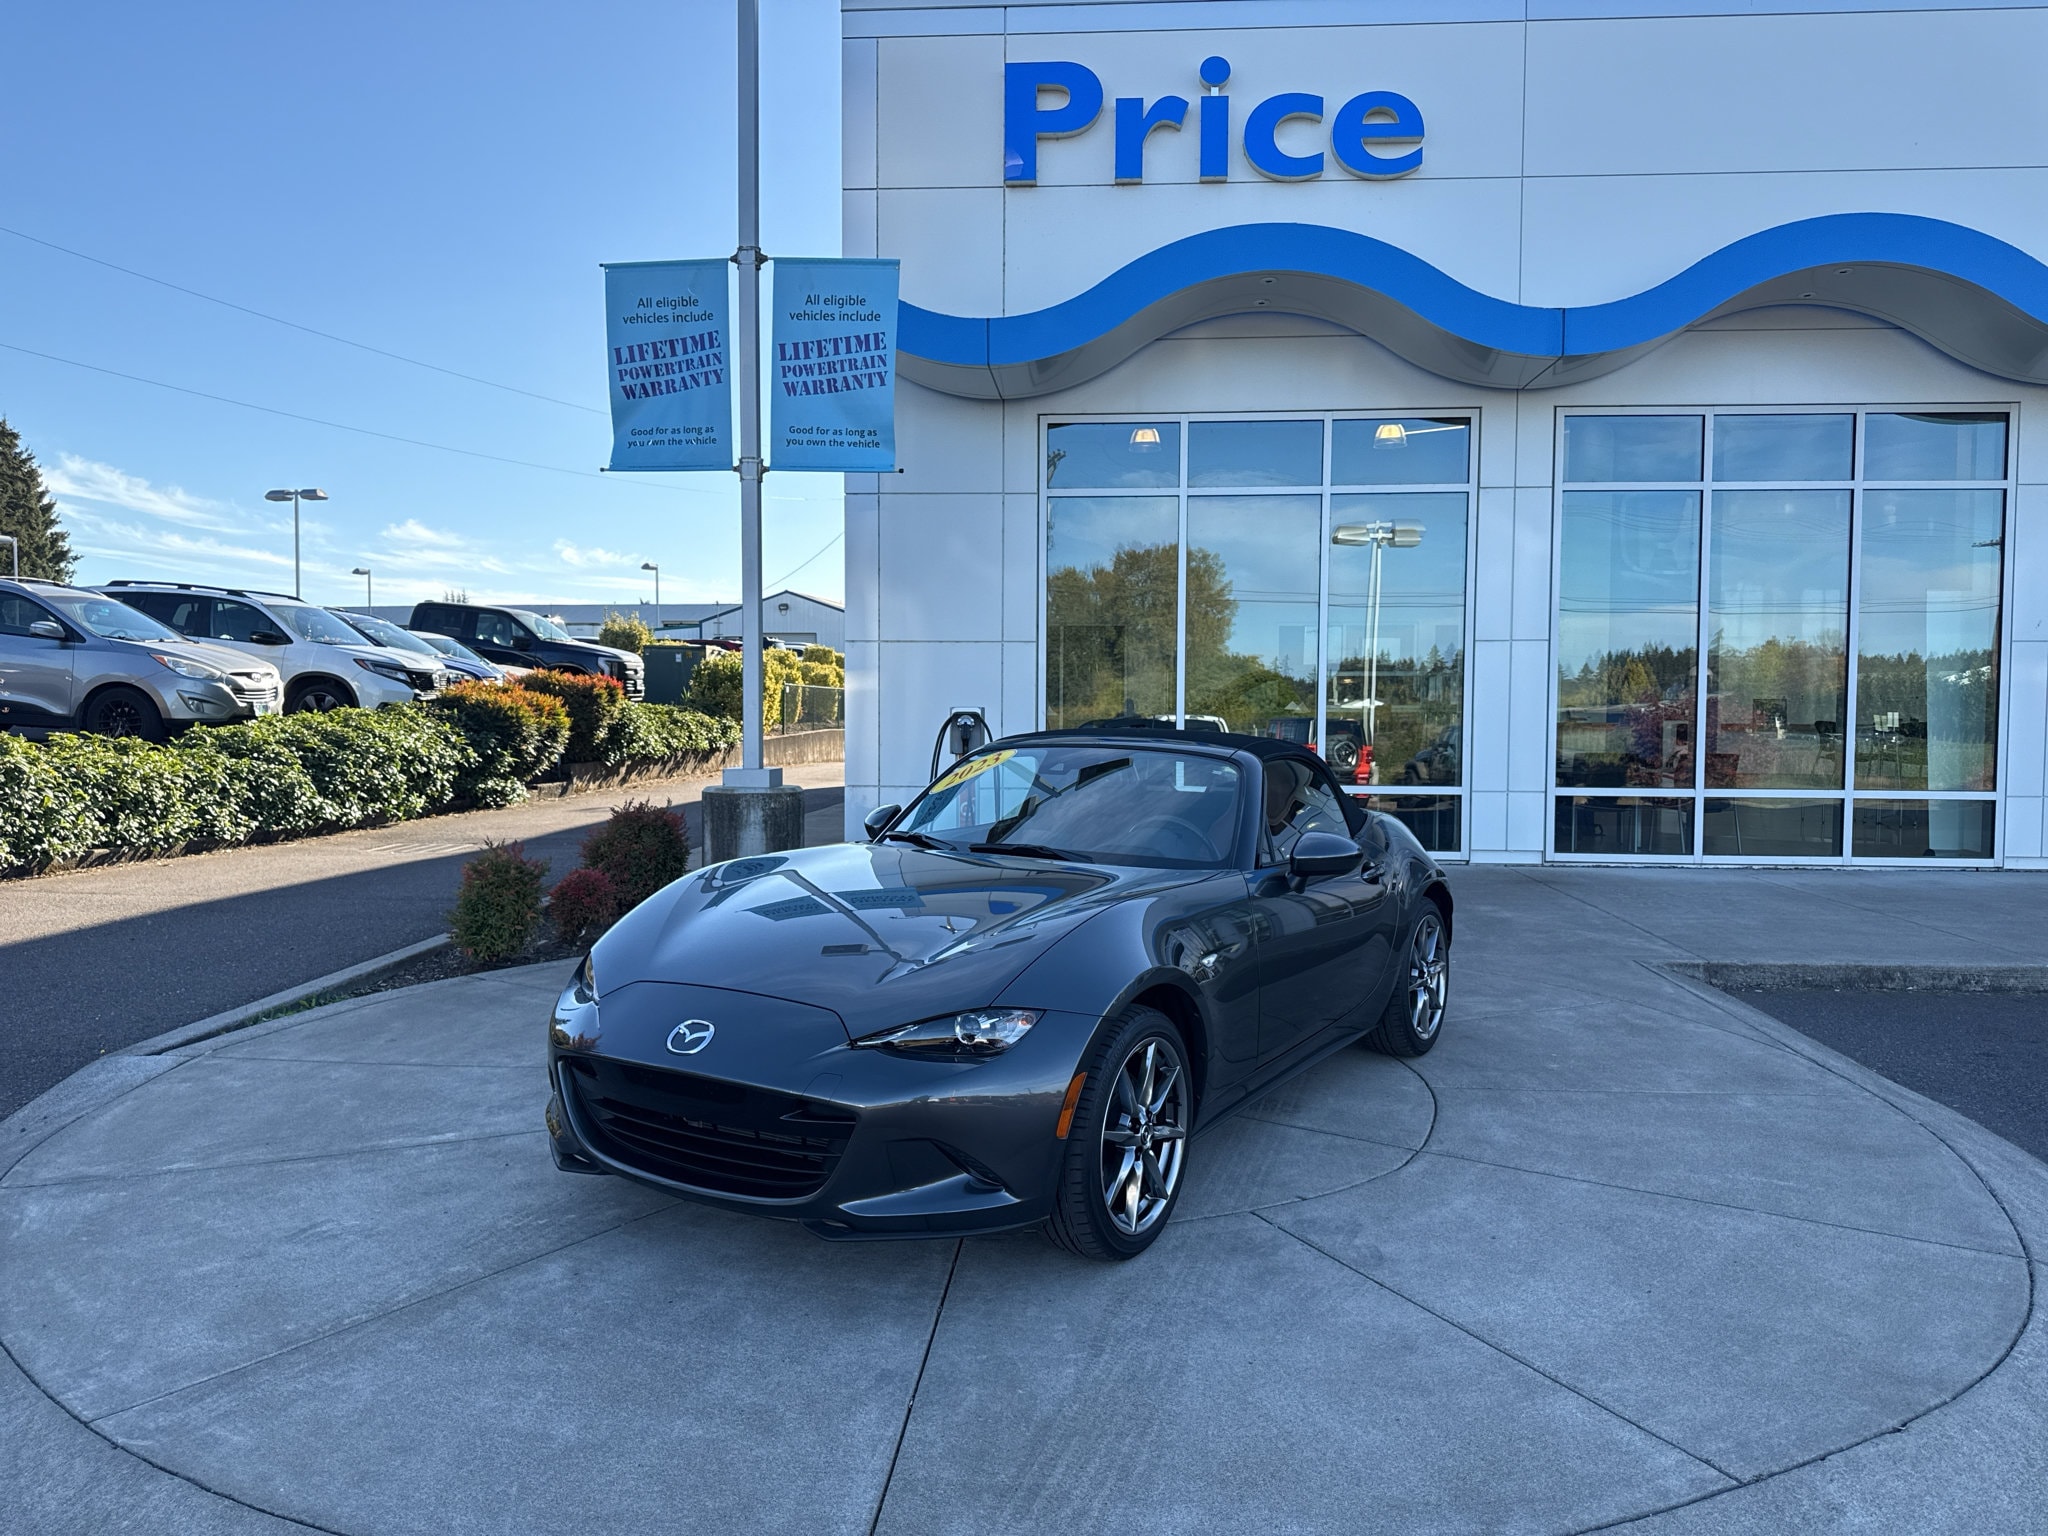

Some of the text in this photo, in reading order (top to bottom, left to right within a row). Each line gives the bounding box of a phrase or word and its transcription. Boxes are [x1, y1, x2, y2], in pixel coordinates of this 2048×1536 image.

[1004, 55, 1425, 187] Price
[637, 296, 699, 310] All eligible
[805, 294, 866, 308] All eligible
[622, 310, 714, 325] vehicles include
[789, 310, 881, 322] vehicles include
[613, 330, 721, 366] LIFETIME
[778, 332, 887, 361] LIFETIME
[618, 352, 722, 382] POWERTRAIN
[780, 354, 888, 379] POWERTRAIN
[621, 368, 724, 400] WARRANTY
[783, 370, 888, 397] WARRANTY
[630, 425, 714, 436] Good for as long as
[789, 425, 877, 438] Good for as long as
[627, 439, 645, 449] you
[668, 437, 683, 446] the
[685, 436, 717, 446] vehicle
[785, 438, 881, 449] you own the vehicle
